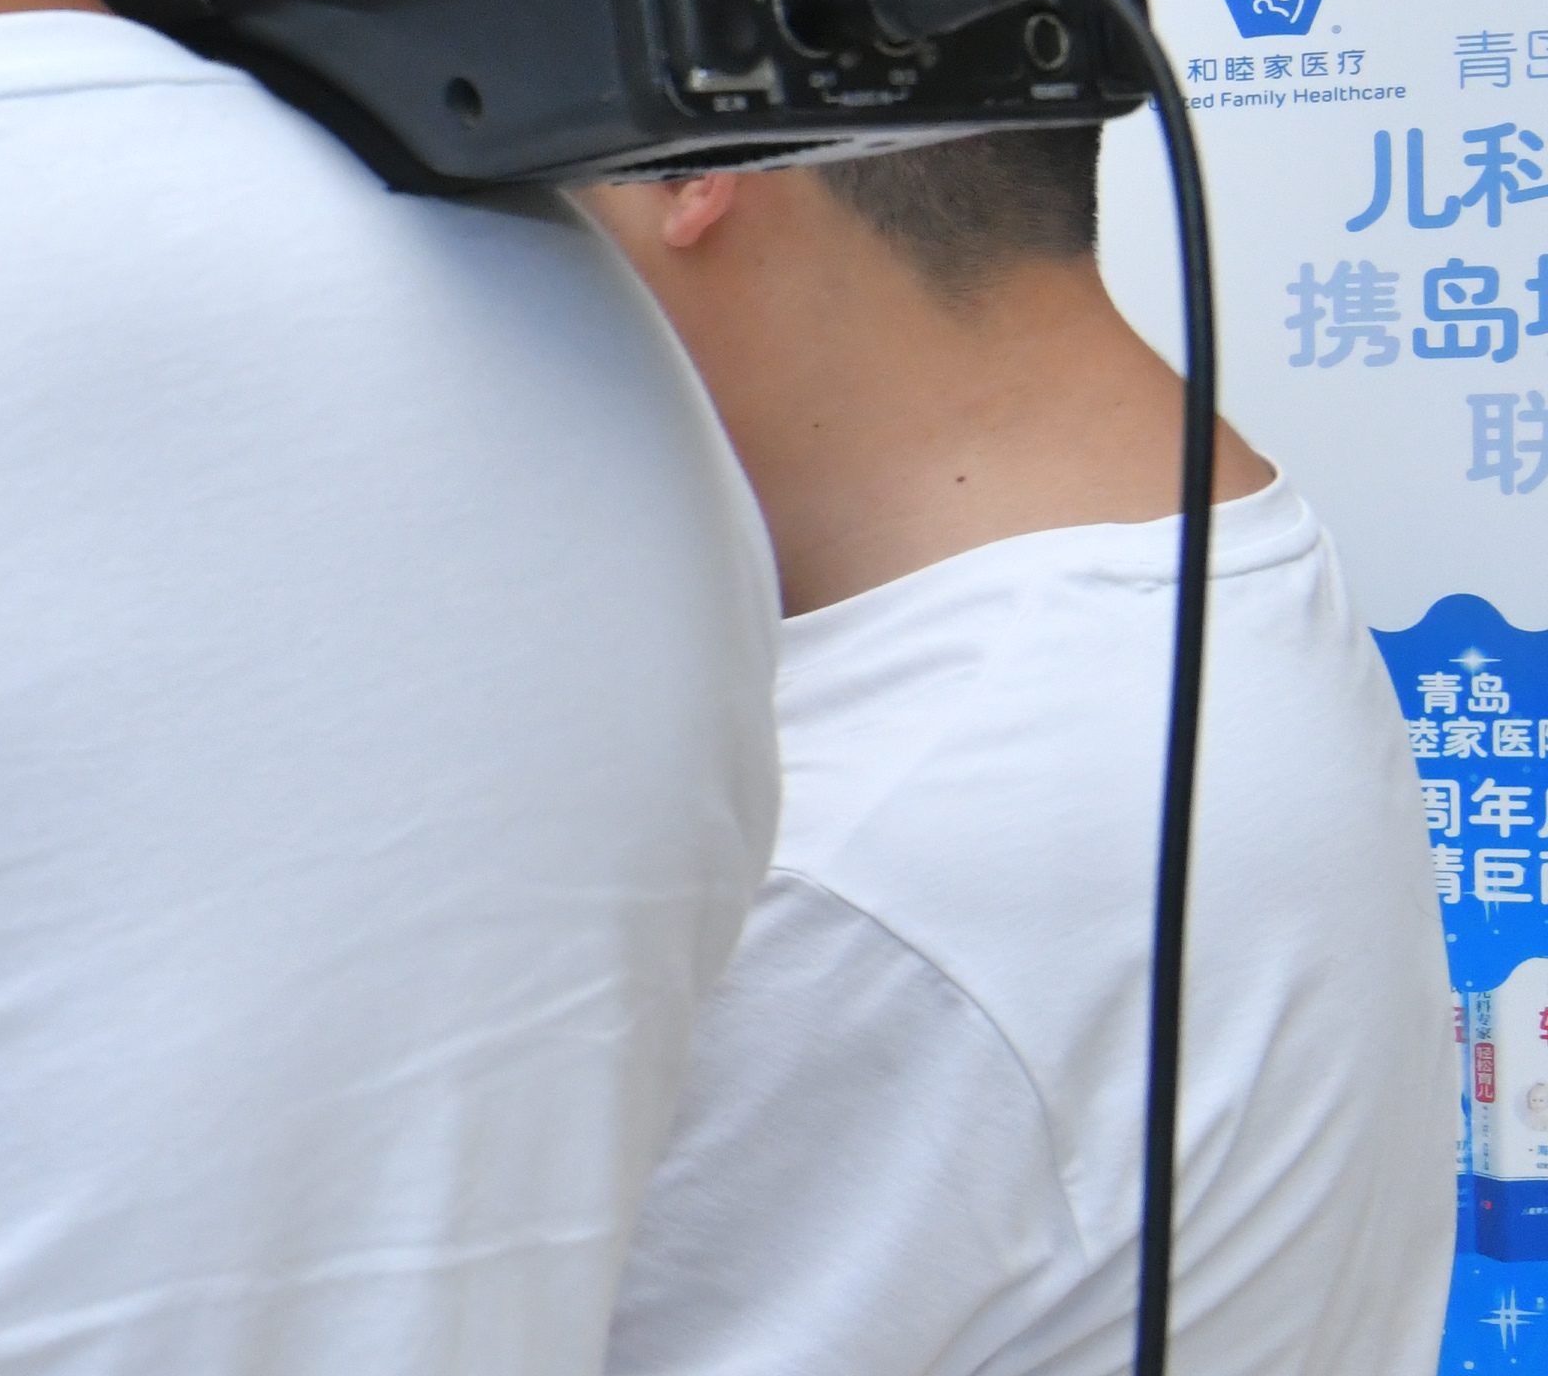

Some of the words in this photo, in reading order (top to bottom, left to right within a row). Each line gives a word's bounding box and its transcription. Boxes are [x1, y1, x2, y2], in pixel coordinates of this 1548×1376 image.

[1187, 49, 1367, 84] 和睦家医疗
[1220, 88, 1286, 109] Family
[1292, 83, 1407, 105] Healthcare
[1284, 253, 1548, 370] 携岛
[1416, 671, 1511, 715] 青岛
[1420, 777, 1548, 839] 周年
